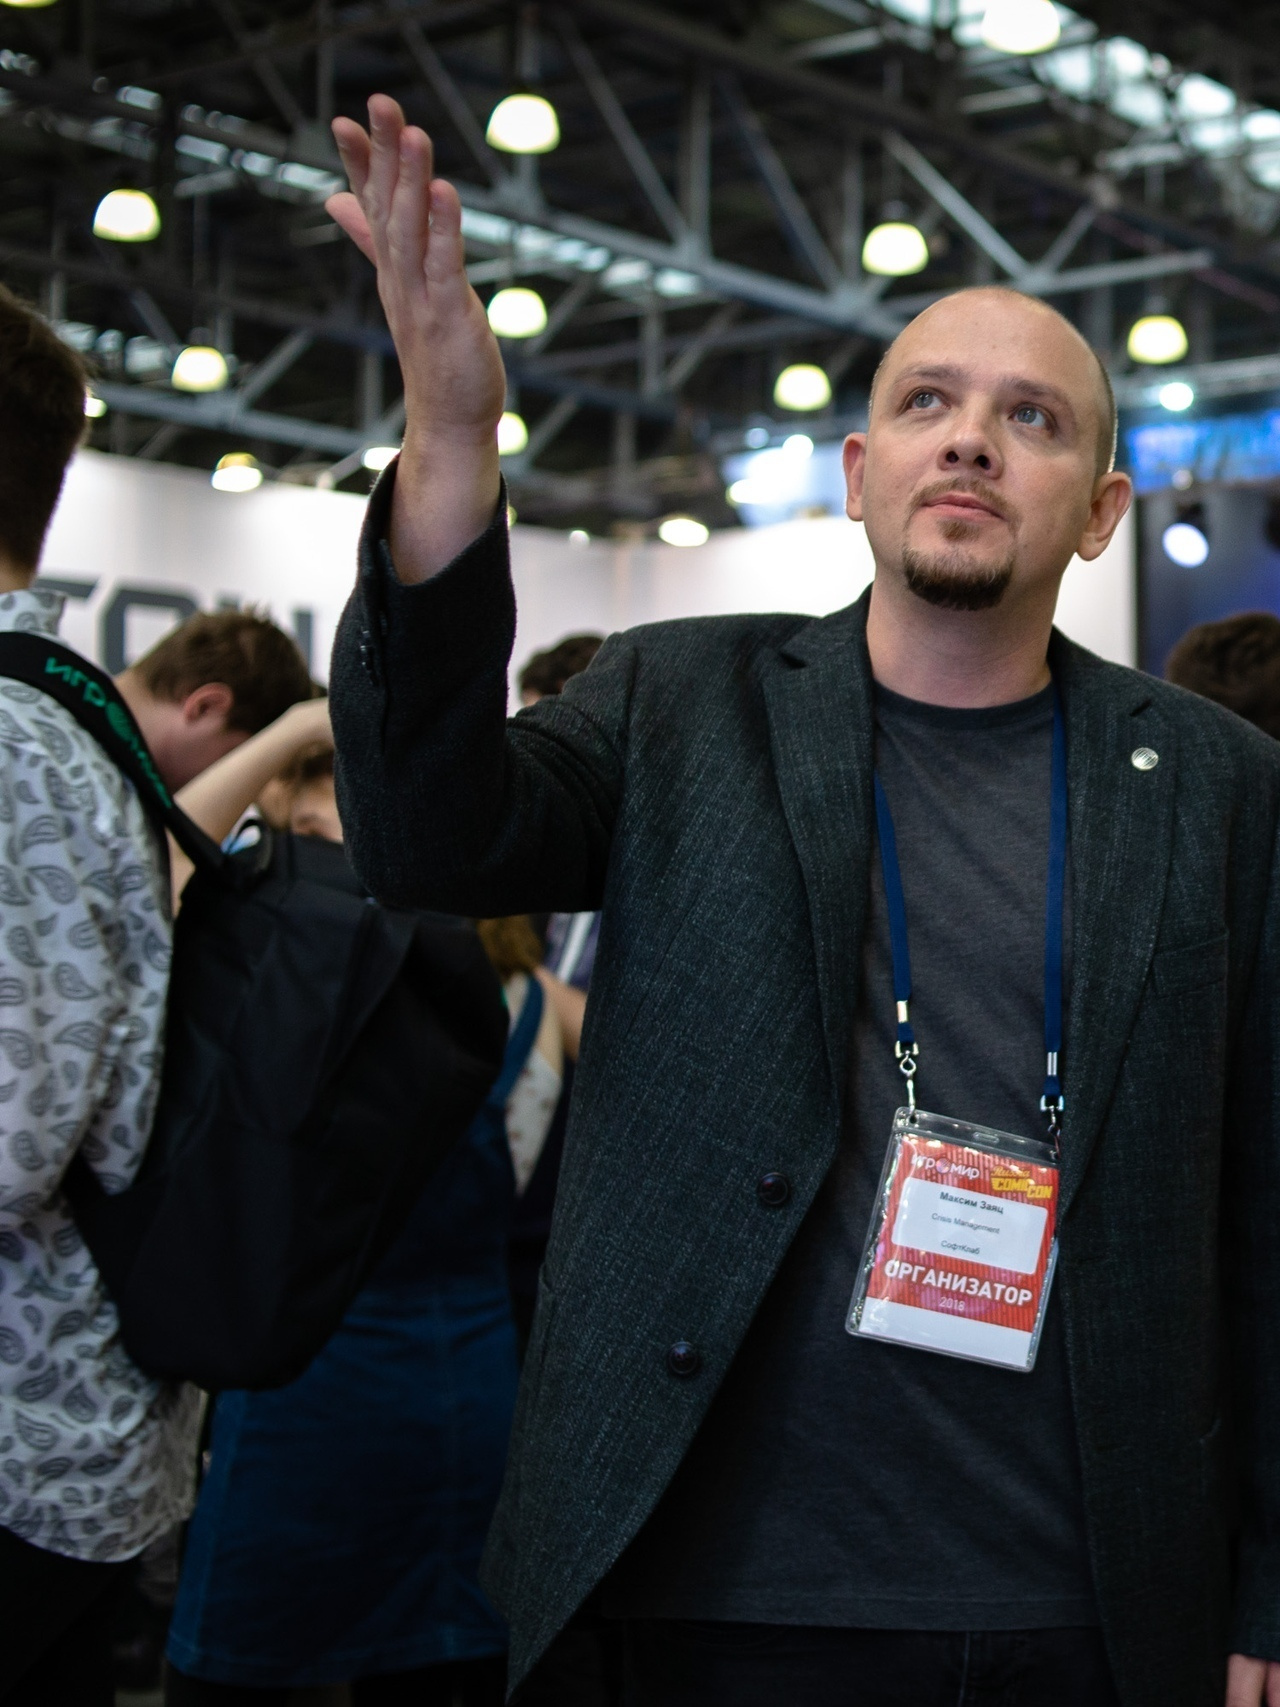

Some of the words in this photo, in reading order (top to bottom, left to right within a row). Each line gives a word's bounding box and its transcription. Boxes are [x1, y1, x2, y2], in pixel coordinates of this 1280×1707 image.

[1026, 1185, 1053, 1199] CON
[940, 1191, 978, 1207] Максим
[980, 1200, 1004, 1215] Заяц
[953, 1217, 1001, 1235] Management
[884, 1259, 1033, 1306] ОРГАНИЗАТОР
[939, 1296, 965, 1311] 2018
